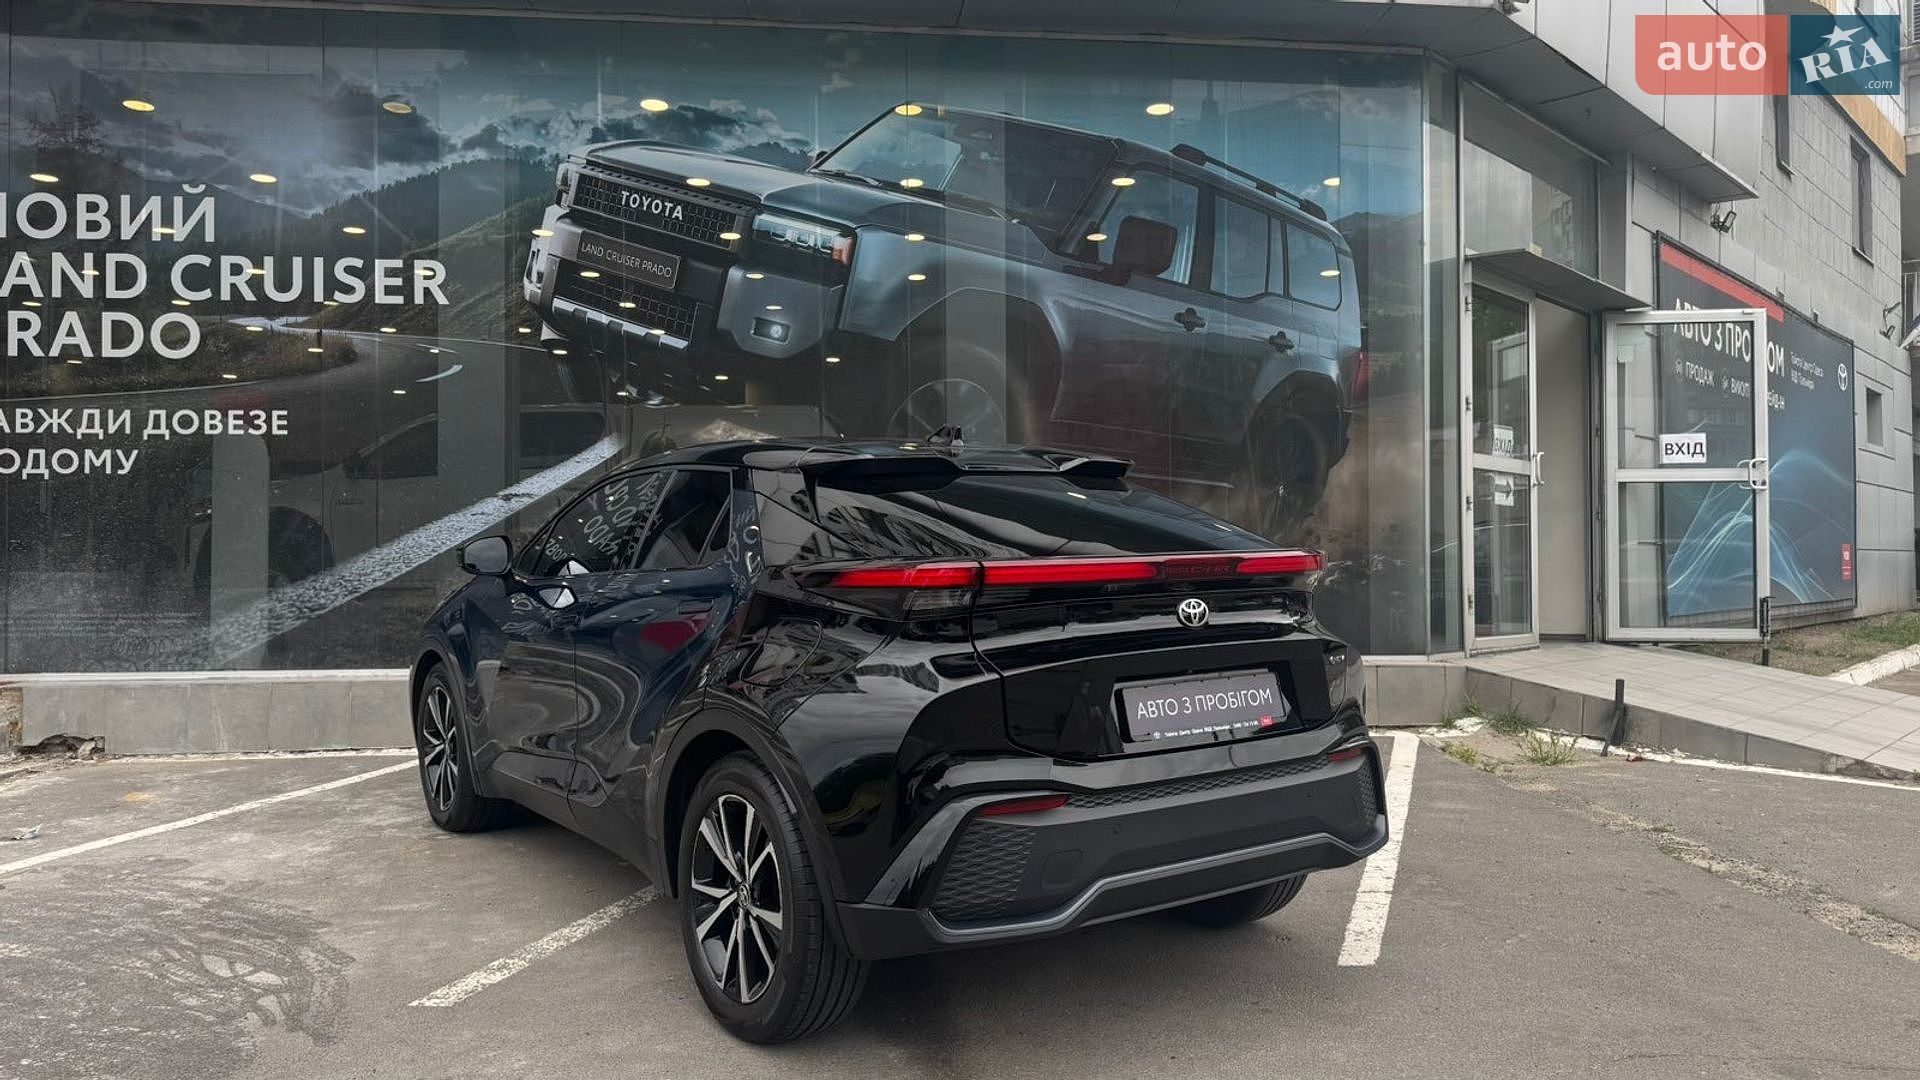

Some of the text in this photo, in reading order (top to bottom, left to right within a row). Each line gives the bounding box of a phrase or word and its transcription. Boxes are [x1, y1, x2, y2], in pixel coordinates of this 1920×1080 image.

[621, 190, 683, 220] TOYOTA
[581, 241, 672, 277] LAND CRUISER PRADO
[170, 254, 450, 305] CRUISER
[1673, 298, 1711, 346] АВТО
[1725, 322, 1785, 377] ПРООМ
[143, 409, 288, 440] ДОВЕЗЕ
[1664, 441, 1705, 458] ВХІД
[1137, 687, 1272, 720] АВТО З ПРОБІГОМ
